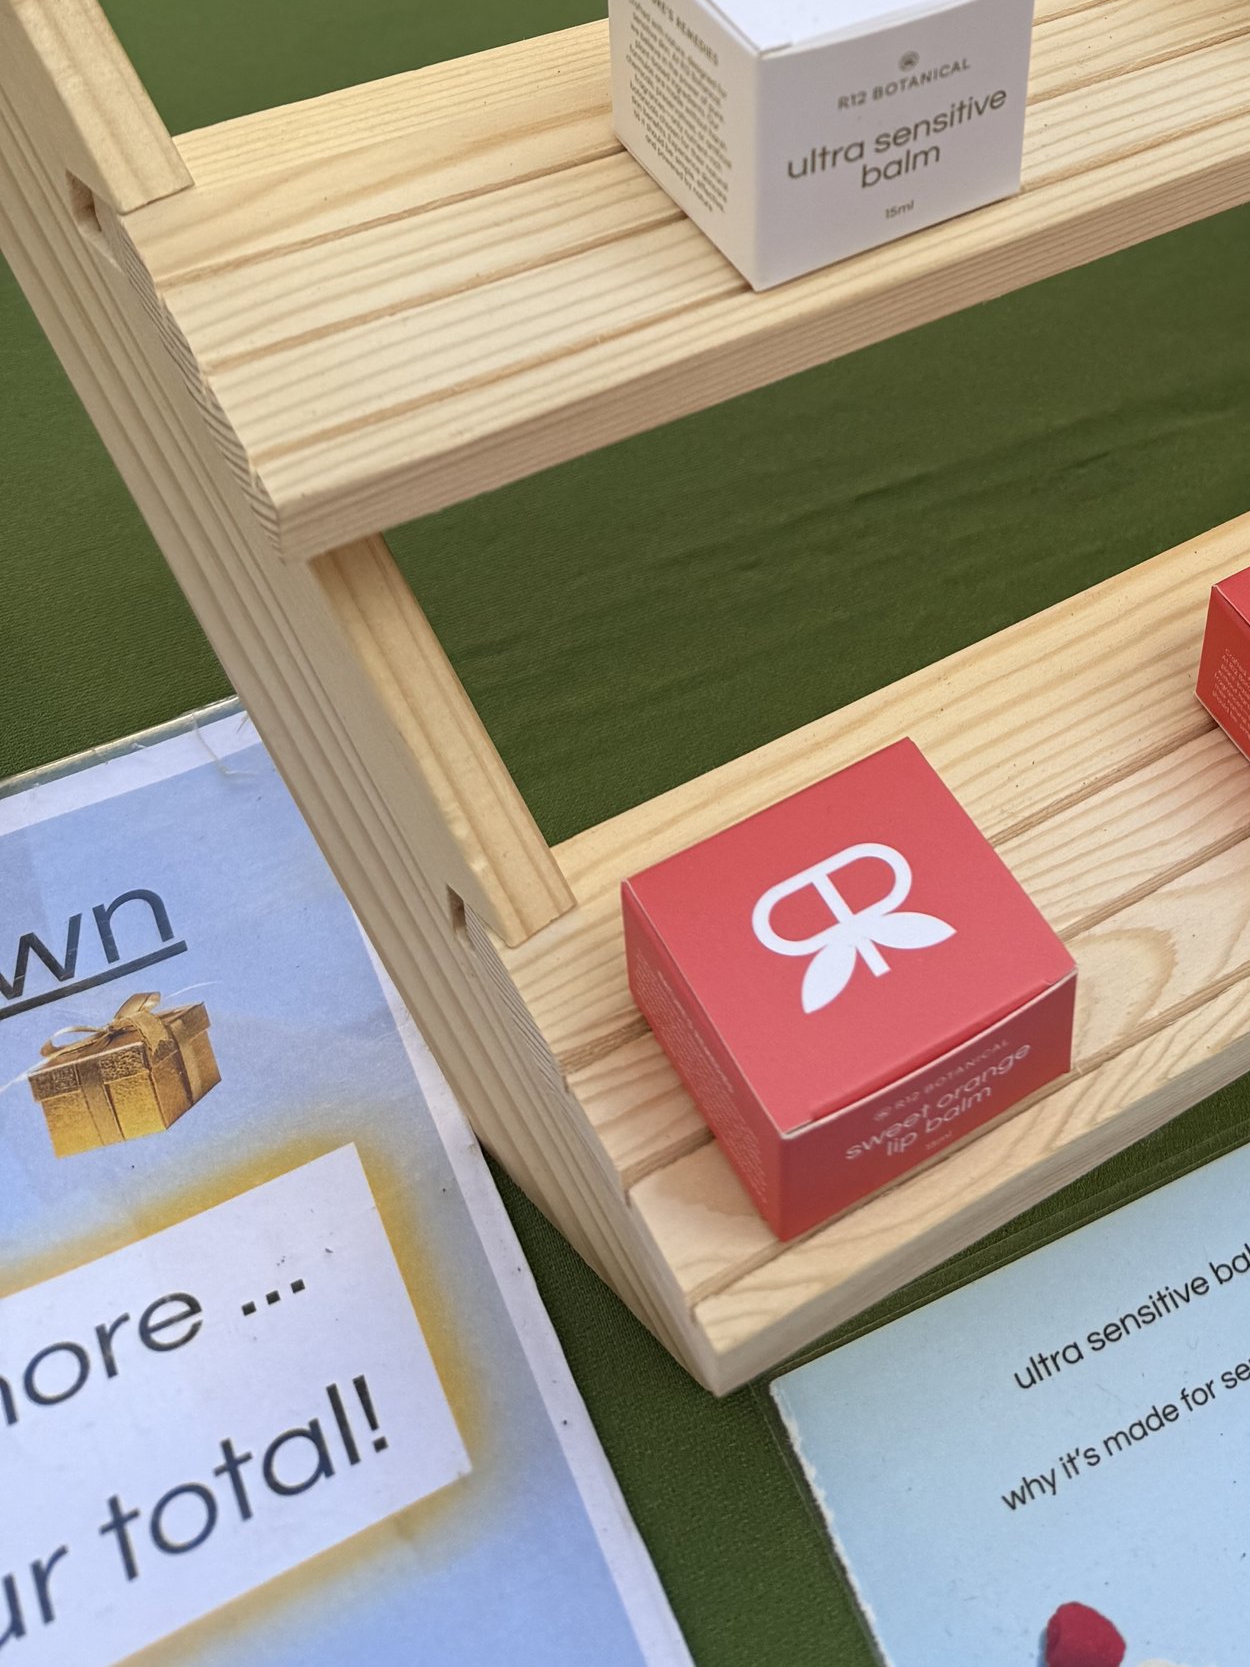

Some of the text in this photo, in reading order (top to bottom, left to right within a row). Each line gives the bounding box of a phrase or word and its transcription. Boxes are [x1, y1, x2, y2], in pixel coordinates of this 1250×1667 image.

[786, 88, 1007, 180] ultra sensitive
[836, 57, 971, 111] R12 BOTANICAL
[860, 144, 941, 189] balm
[845, 1044, 1031, 1160] sweet orange
[886, 1132, 917, 1157] lip
[925, 1086, 992, 1133] balm
[0, 1291, 203, 1426] ore
[1013, 1341, 1085, 1390] ultra
[1086, 1275, 1210, 1352] sensitive
[99, 1375, 391, 1584] total!
[1000, 1467, 1057, 1511] why
[1058, 1446, 1101, 1480] it's
[1102, 1403, 1180, 1457] made
[1179, 1378, 1216, 1412] for
